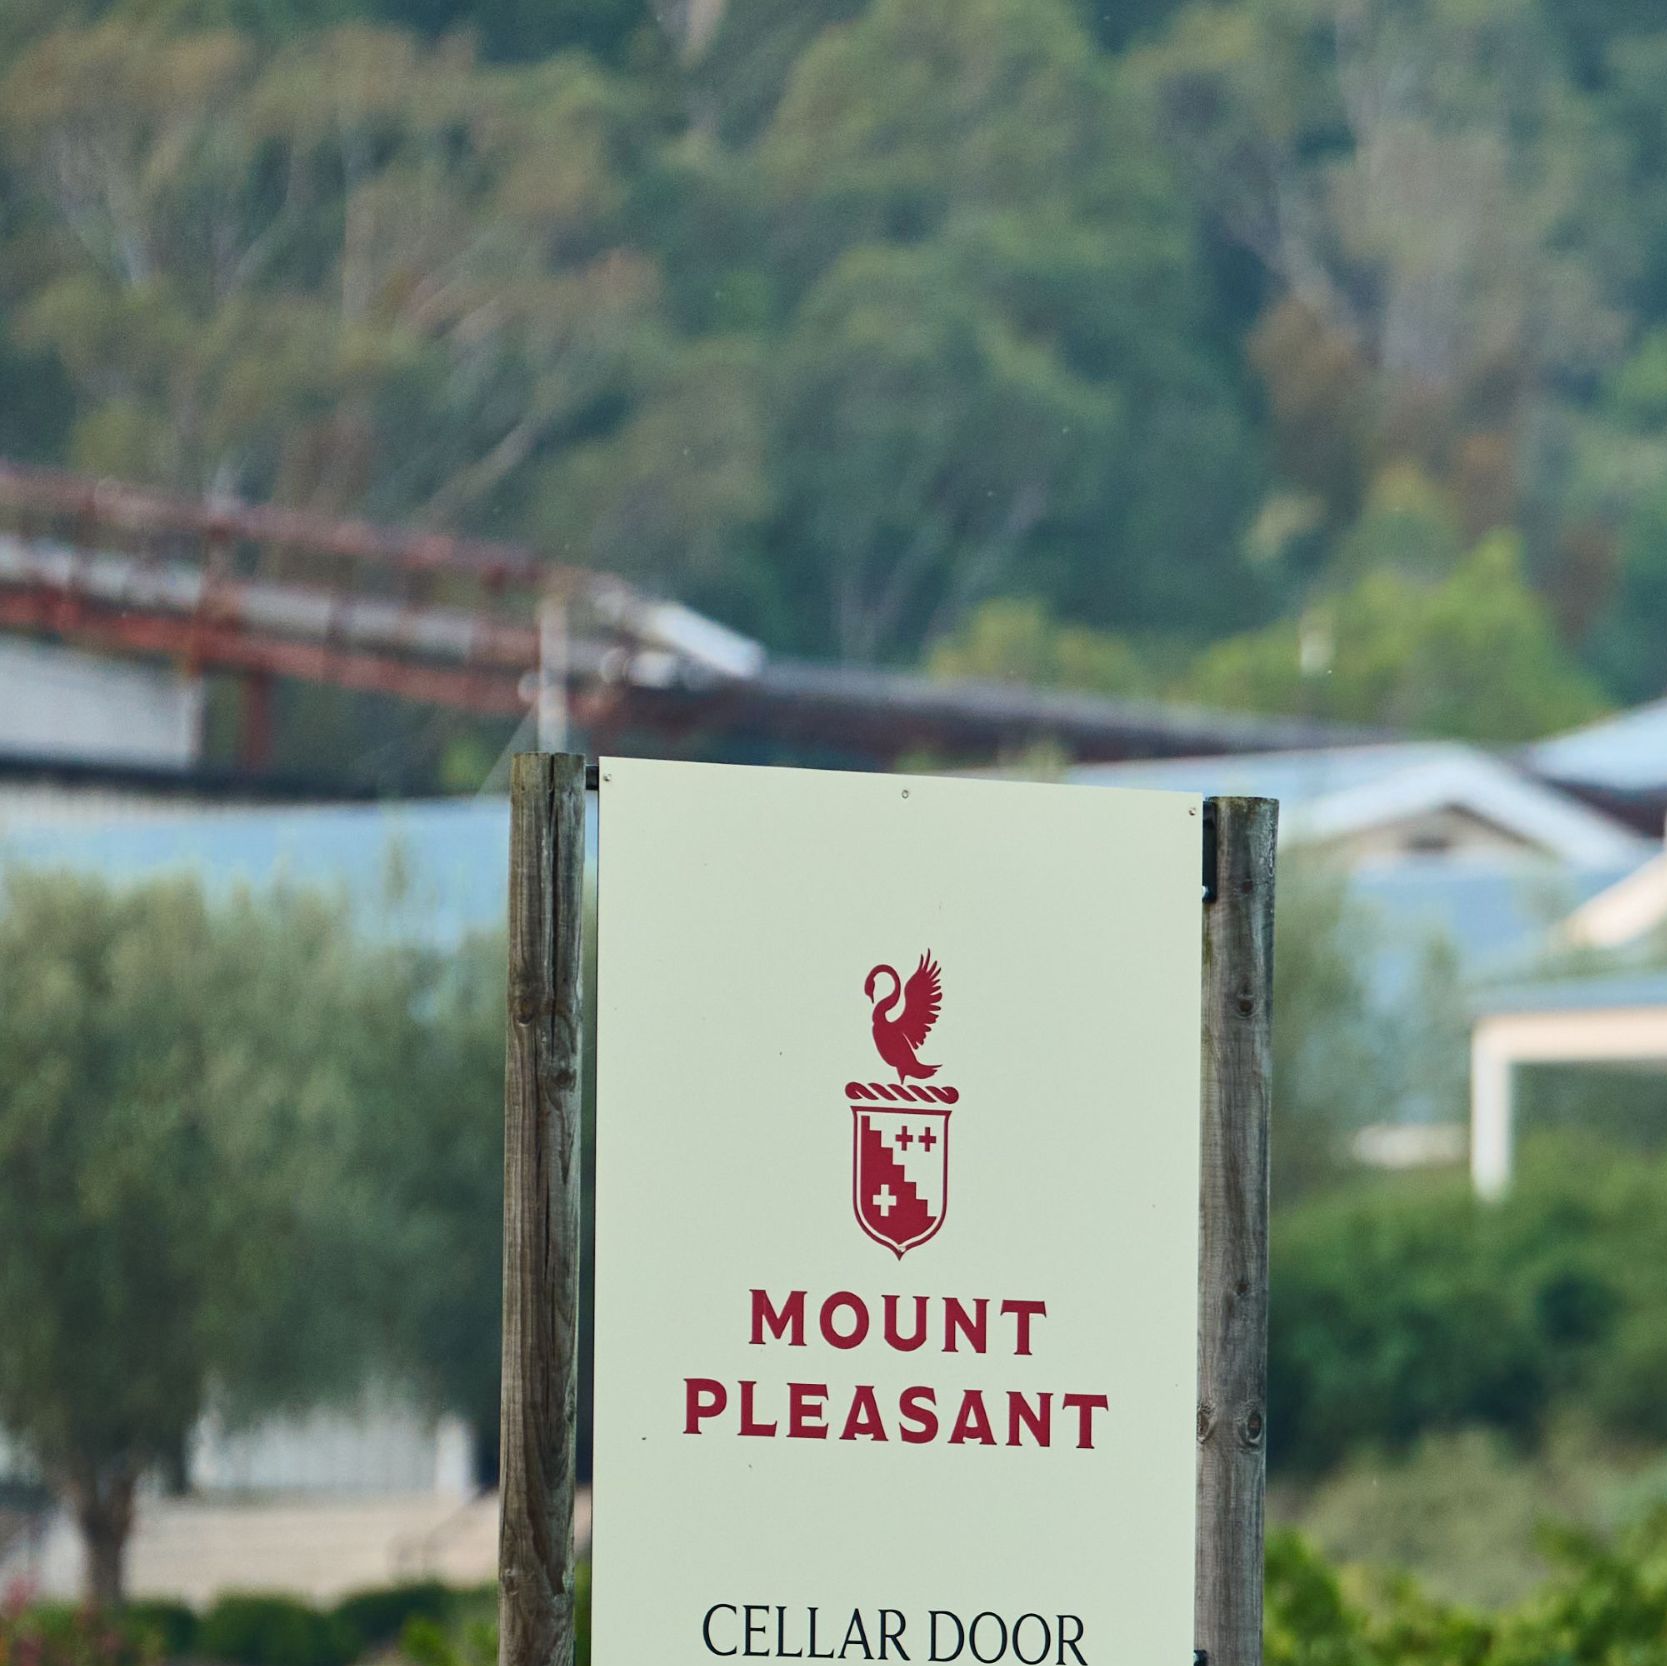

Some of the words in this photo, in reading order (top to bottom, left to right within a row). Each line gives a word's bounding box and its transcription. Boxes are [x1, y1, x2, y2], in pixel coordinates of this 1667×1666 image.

[747, 1288, 1048, 1357] MOUNT
[681, 1377, 1110, 1450] PLEASANT
[702, 1603, 912, 1662] CELLAR
[927, 1609, 1089, 1666] DOOR
